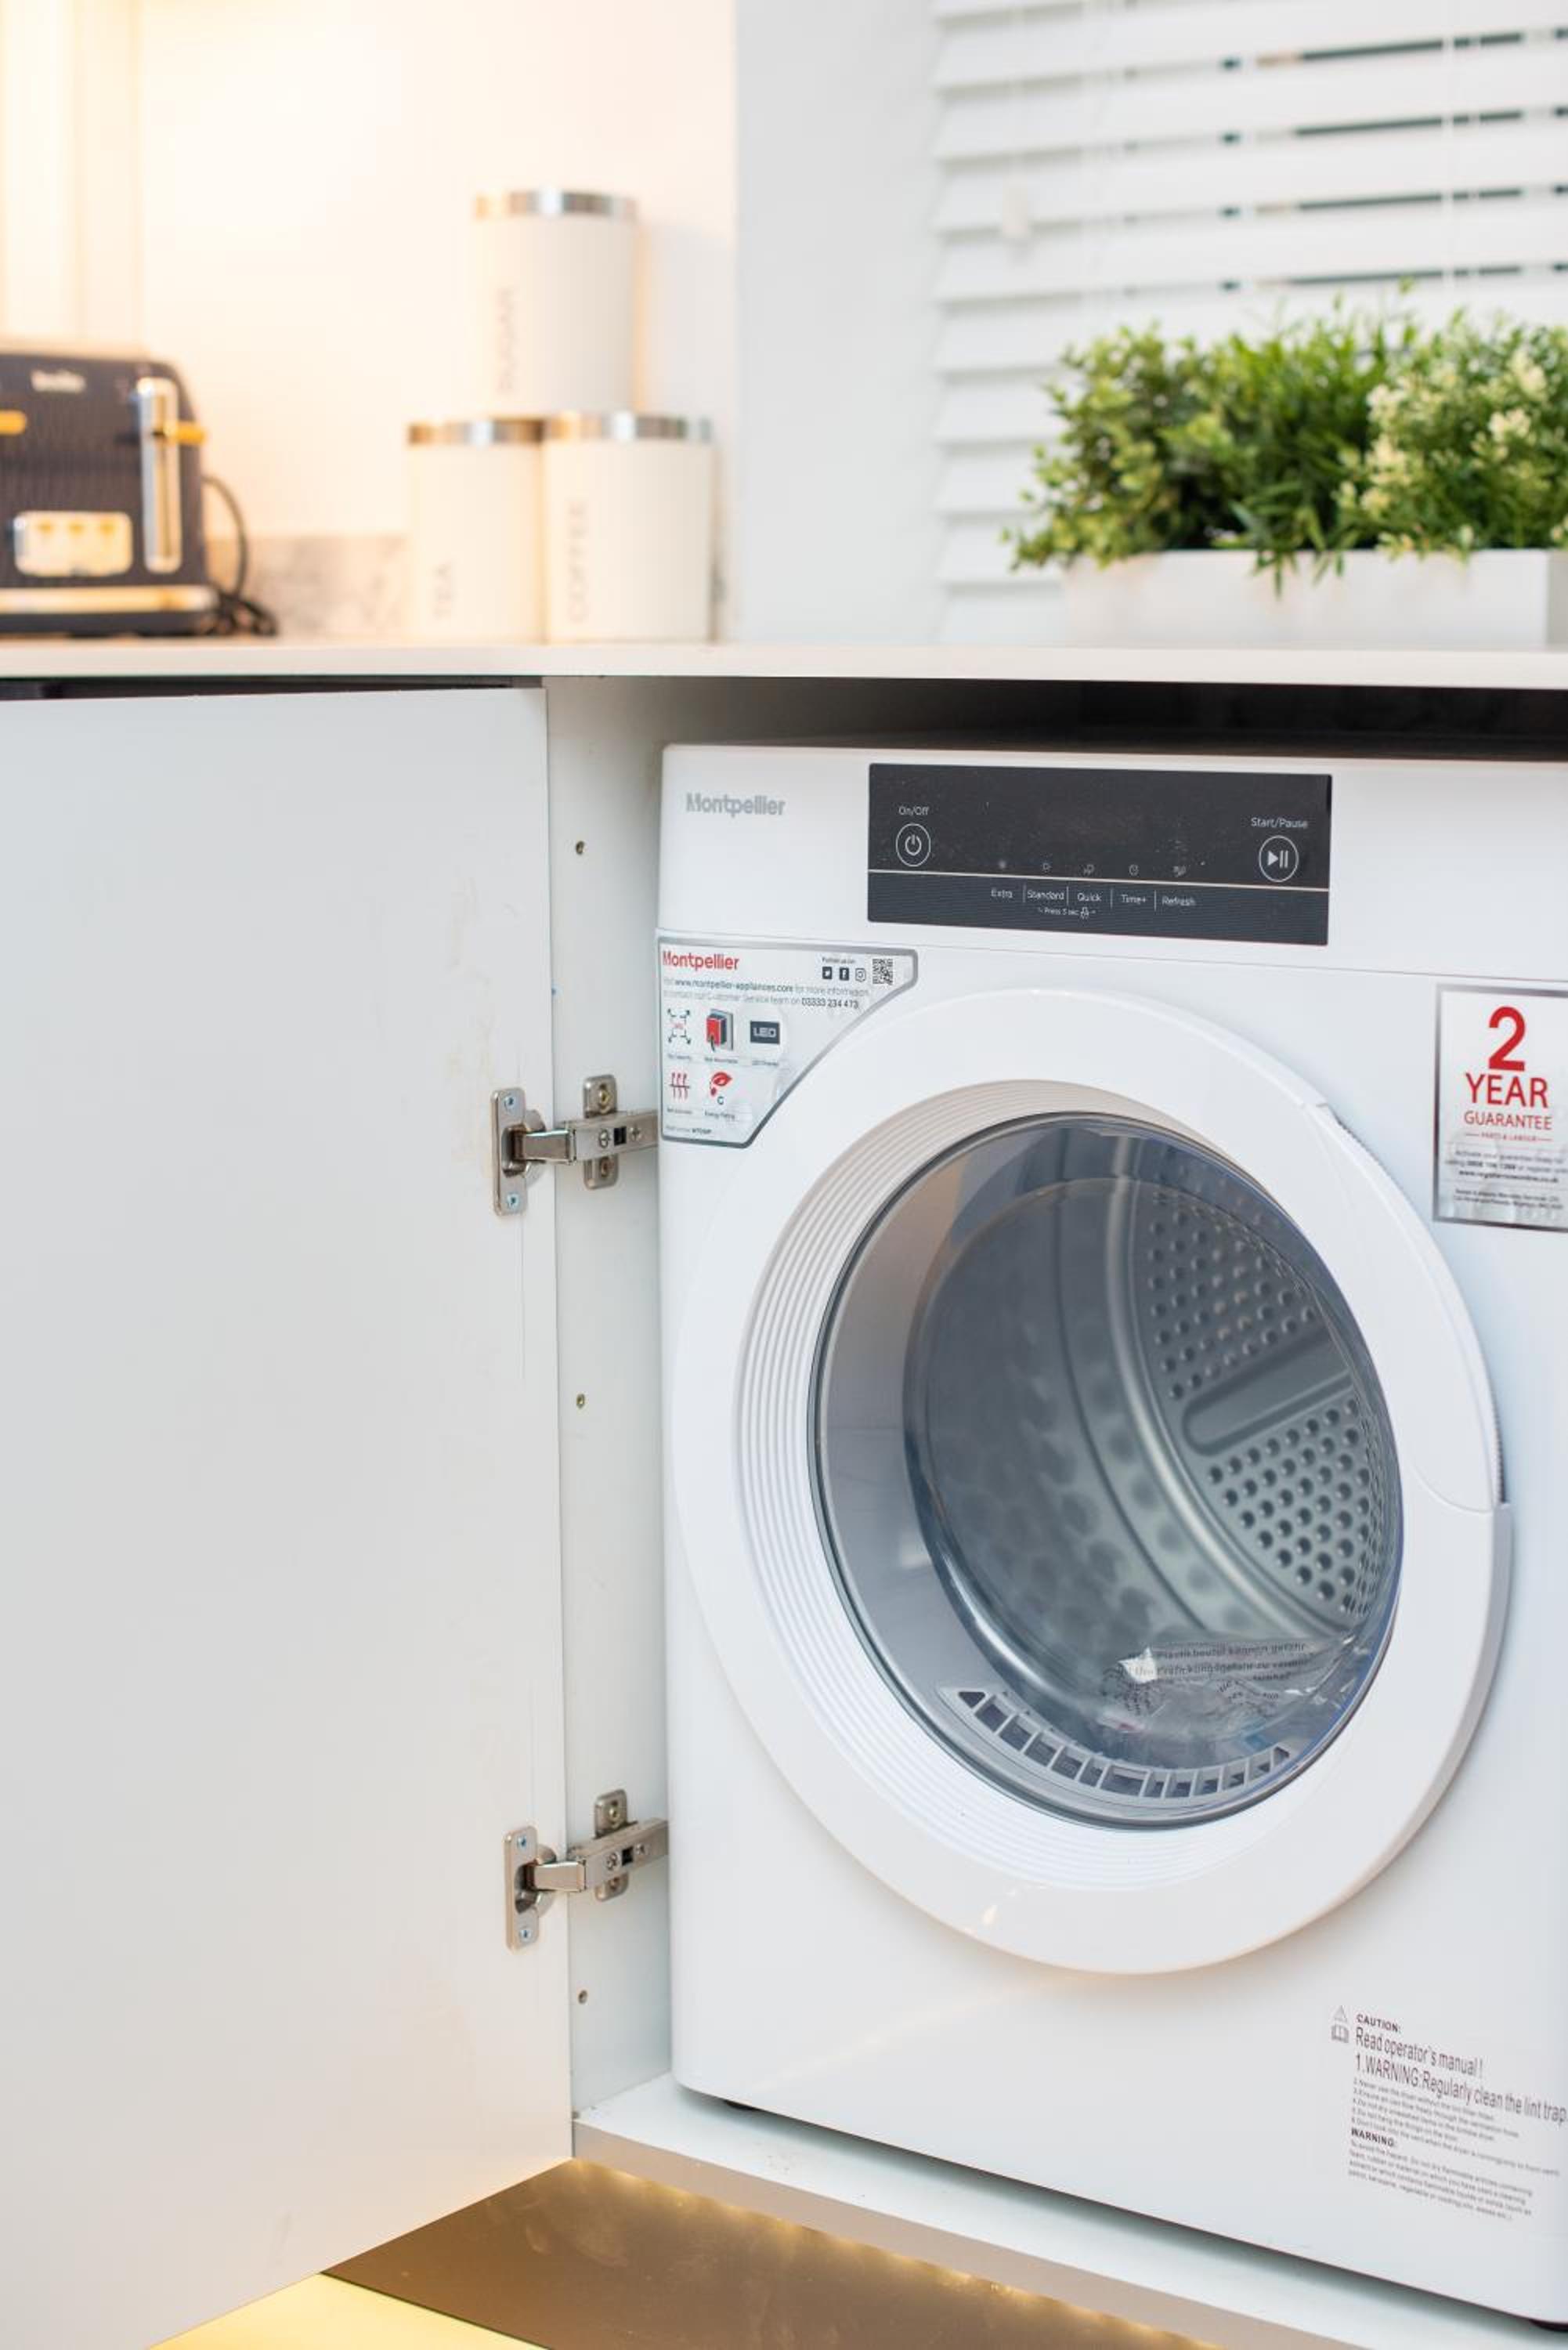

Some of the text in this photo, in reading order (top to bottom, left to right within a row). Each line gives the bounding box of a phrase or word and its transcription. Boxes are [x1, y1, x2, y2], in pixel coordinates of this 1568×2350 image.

[565, 498, 590, 625] COFFEE
[433, 559, 455, 620] TEA
[685, 793, 786, 819] Montpellier
[898, 805, 929, 815] On/Off
[1251, 816, 1308, 830] Start/Pause
[991, 888, 1013, 898] Extra
[1027, 889, 1064, 901] Standard
[1077, 892, 1102, 902] Quick
[1121, 894, 1147, 904] Time+
[1162, 895, 1196, 906] Refresh
[662, 949, 740, 971] Montpellier
[674, 980, 793, 992] www.montpellier-appliances.com
[801, 996, 826, 1007] 03333
[827, 998, 843, 1009] 234
[753, 1026, 777, 1038] LED
[1489, 1006, 1525, 1072] 2
[1465, 1073, 1548, 1108] YEAR
[1464, 1110, 1552, 1130] GUARANTEE
[1357, 2013, 1401, 2034] CAUTION:
[1356, 2026, 1382, 2052] Read
[1439, 2052, 1478, 2076] manual
[1474, 2084, 1503, 2109] clean
[1505, 2092, 1523, 2115] the
[1524, 2095, 1542, 2120] lint
